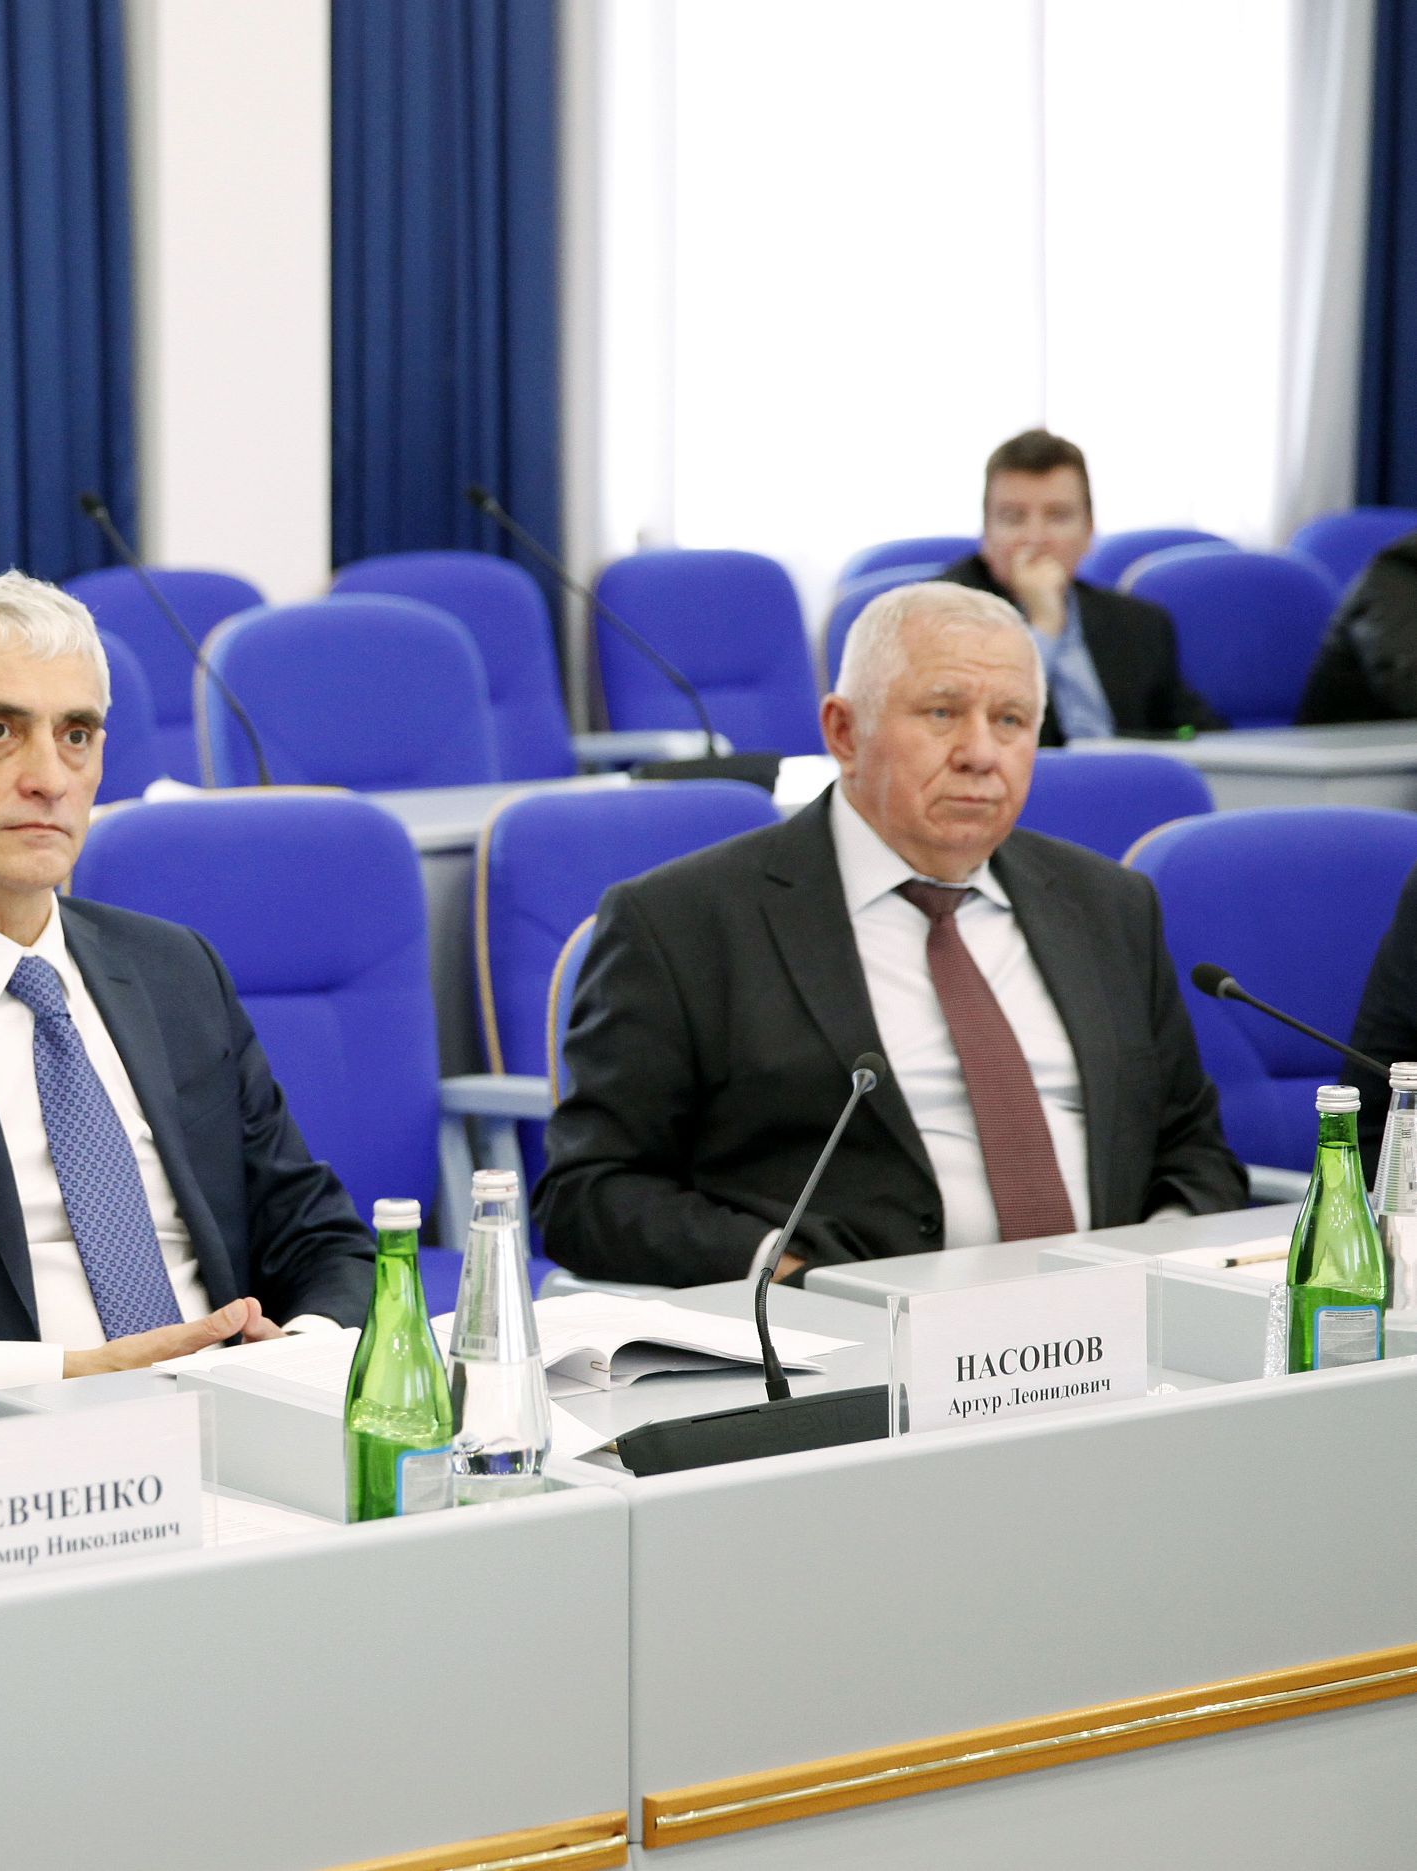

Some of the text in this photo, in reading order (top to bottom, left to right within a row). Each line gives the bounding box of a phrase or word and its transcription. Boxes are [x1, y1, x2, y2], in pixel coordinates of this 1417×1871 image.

[956, 1336, 1104, 1382] НАСОНОВ
[948, 1378, 1112, 1418] Артур Леонидович
[47, 1522, 181, 1556] Николаевич
